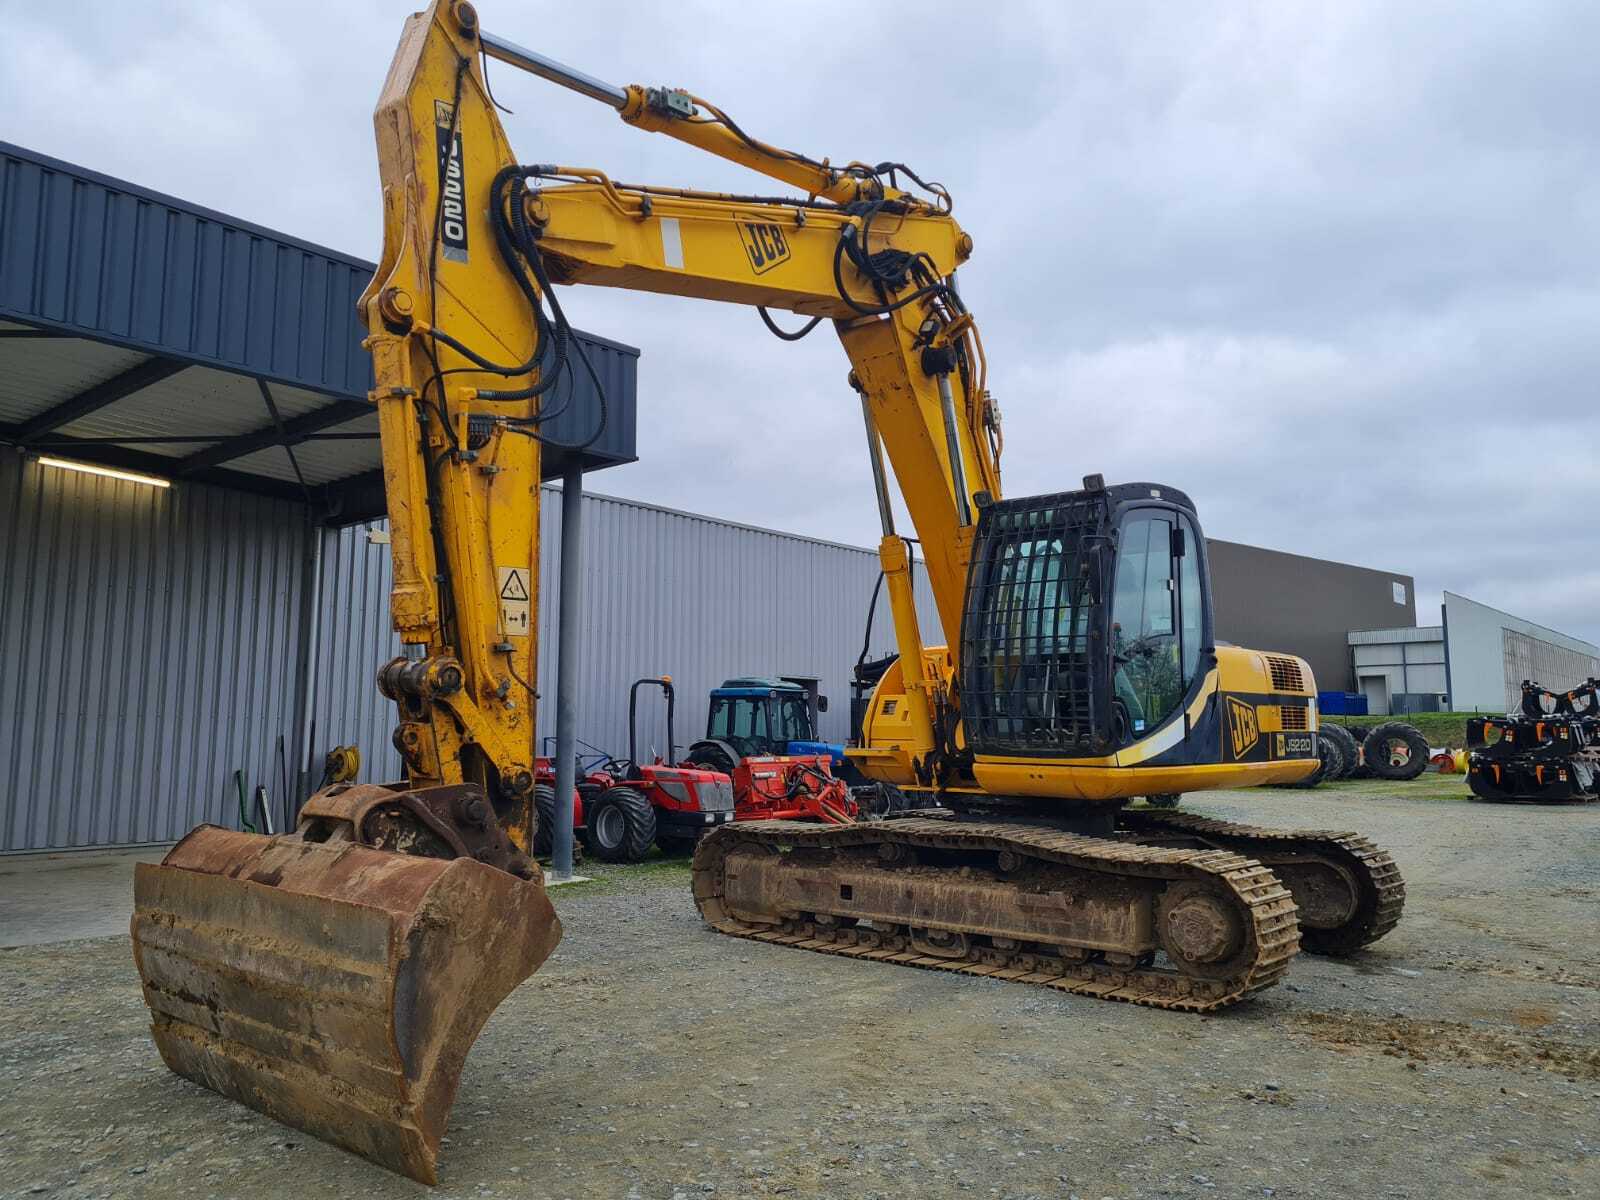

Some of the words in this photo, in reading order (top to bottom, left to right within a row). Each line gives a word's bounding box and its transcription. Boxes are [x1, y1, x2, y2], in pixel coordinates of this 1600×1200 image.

[744, 221, 786, 268] JCB
[1231, 702, 1257, 754] JCB
[1285, 738, 1312, 752] JS220
